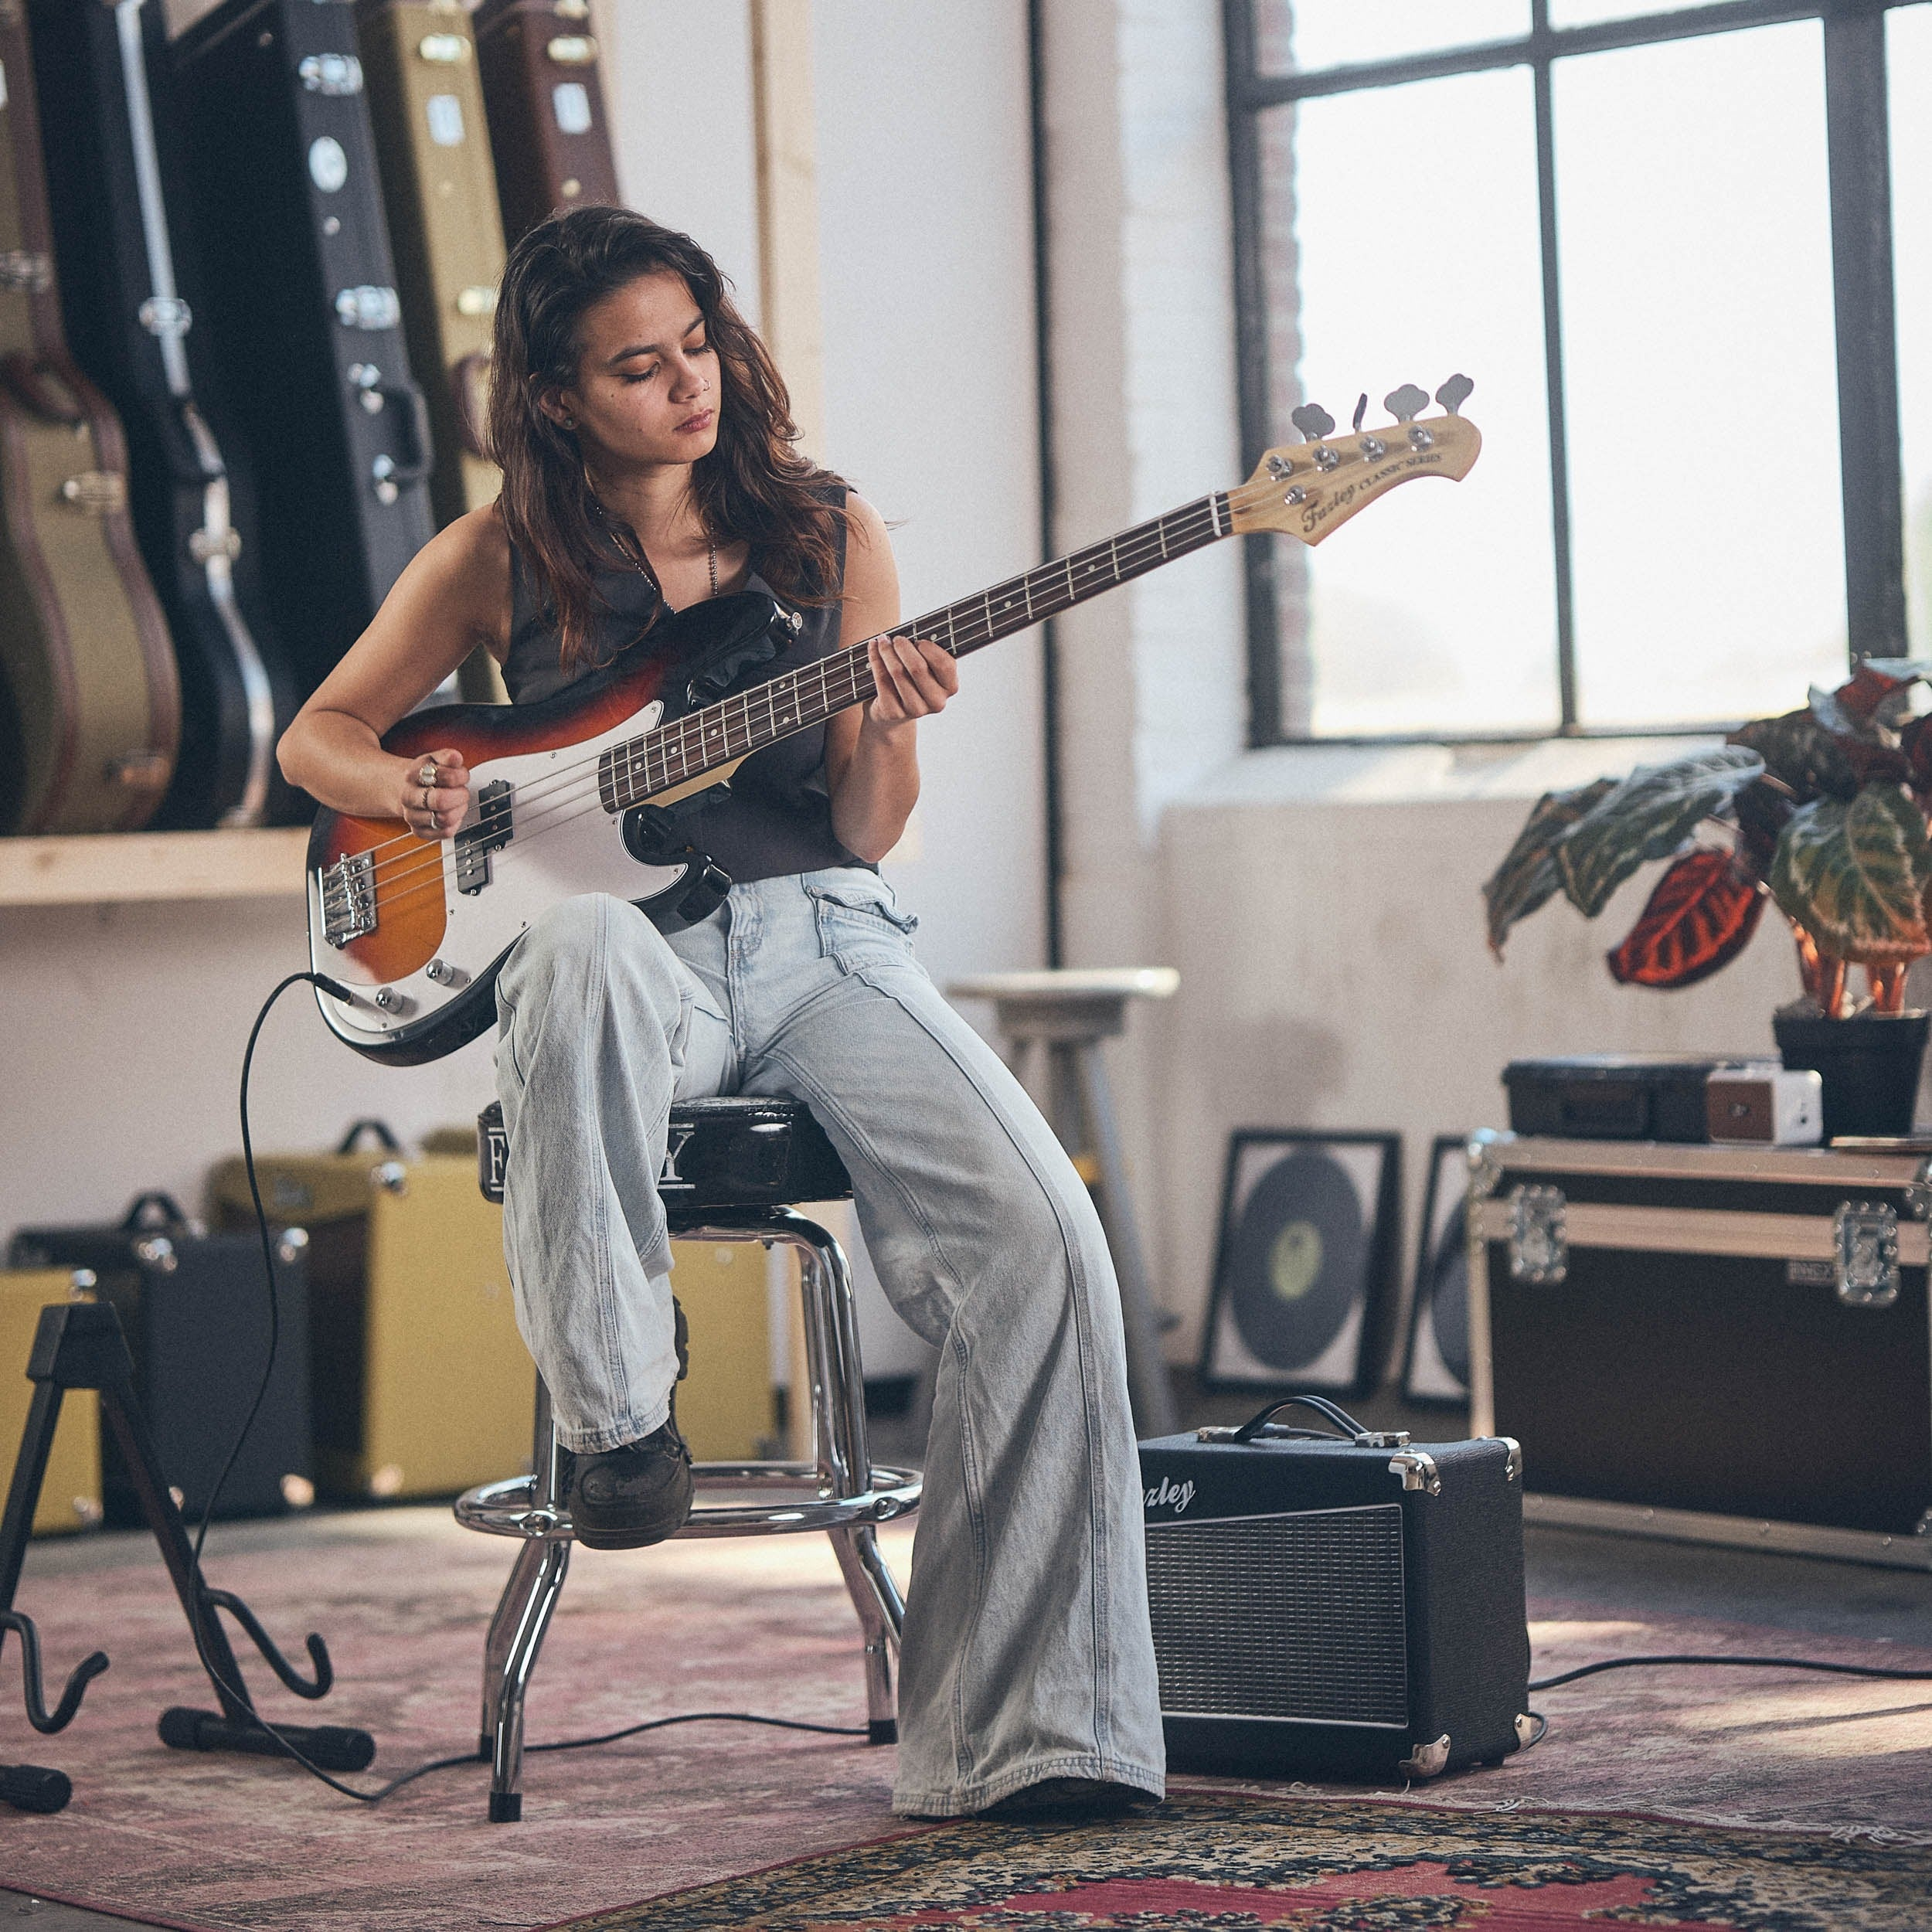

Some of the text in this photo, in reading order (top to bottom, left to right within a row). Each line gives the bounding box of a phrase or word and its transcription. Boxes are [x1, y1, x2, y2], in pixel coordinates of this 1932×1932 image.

[1359, 461, 1404, 490] CLASSIC
[1406, 453, 1441, 467] SERIES
[1143, 1476, 1196, 1513] zley
